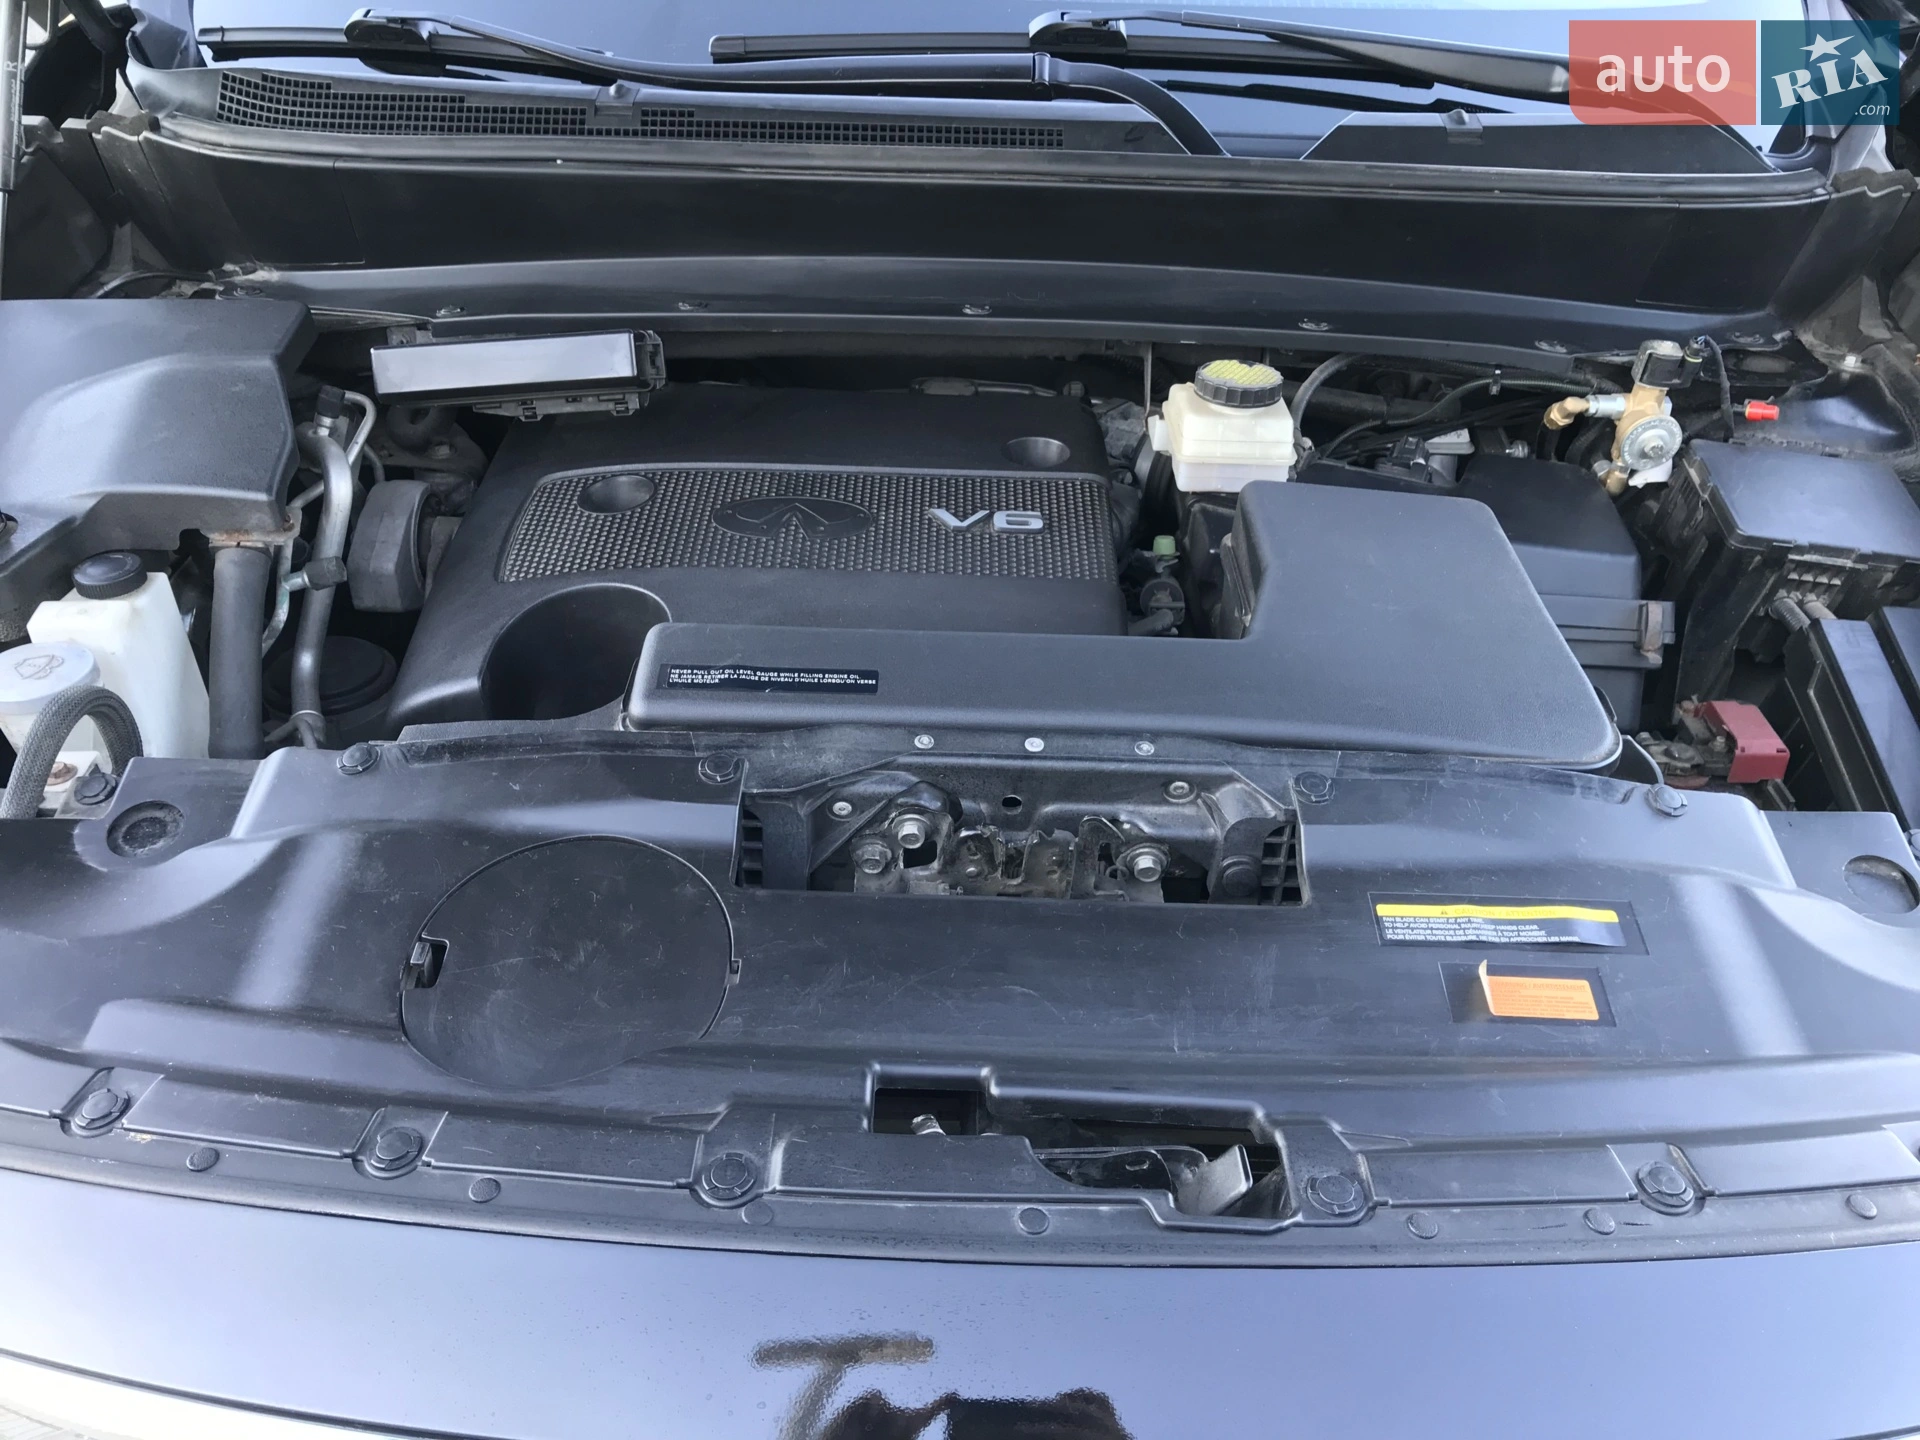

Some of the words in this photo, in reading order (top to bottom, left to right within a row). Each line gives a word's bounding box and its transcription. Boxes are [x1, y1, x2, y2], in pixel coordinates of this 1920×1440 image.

[928, 508, 1044, 534] V6
[1454, 908, 1495, 916] CAUTION
[1505, 909, 1557, 917] ATTENTION
